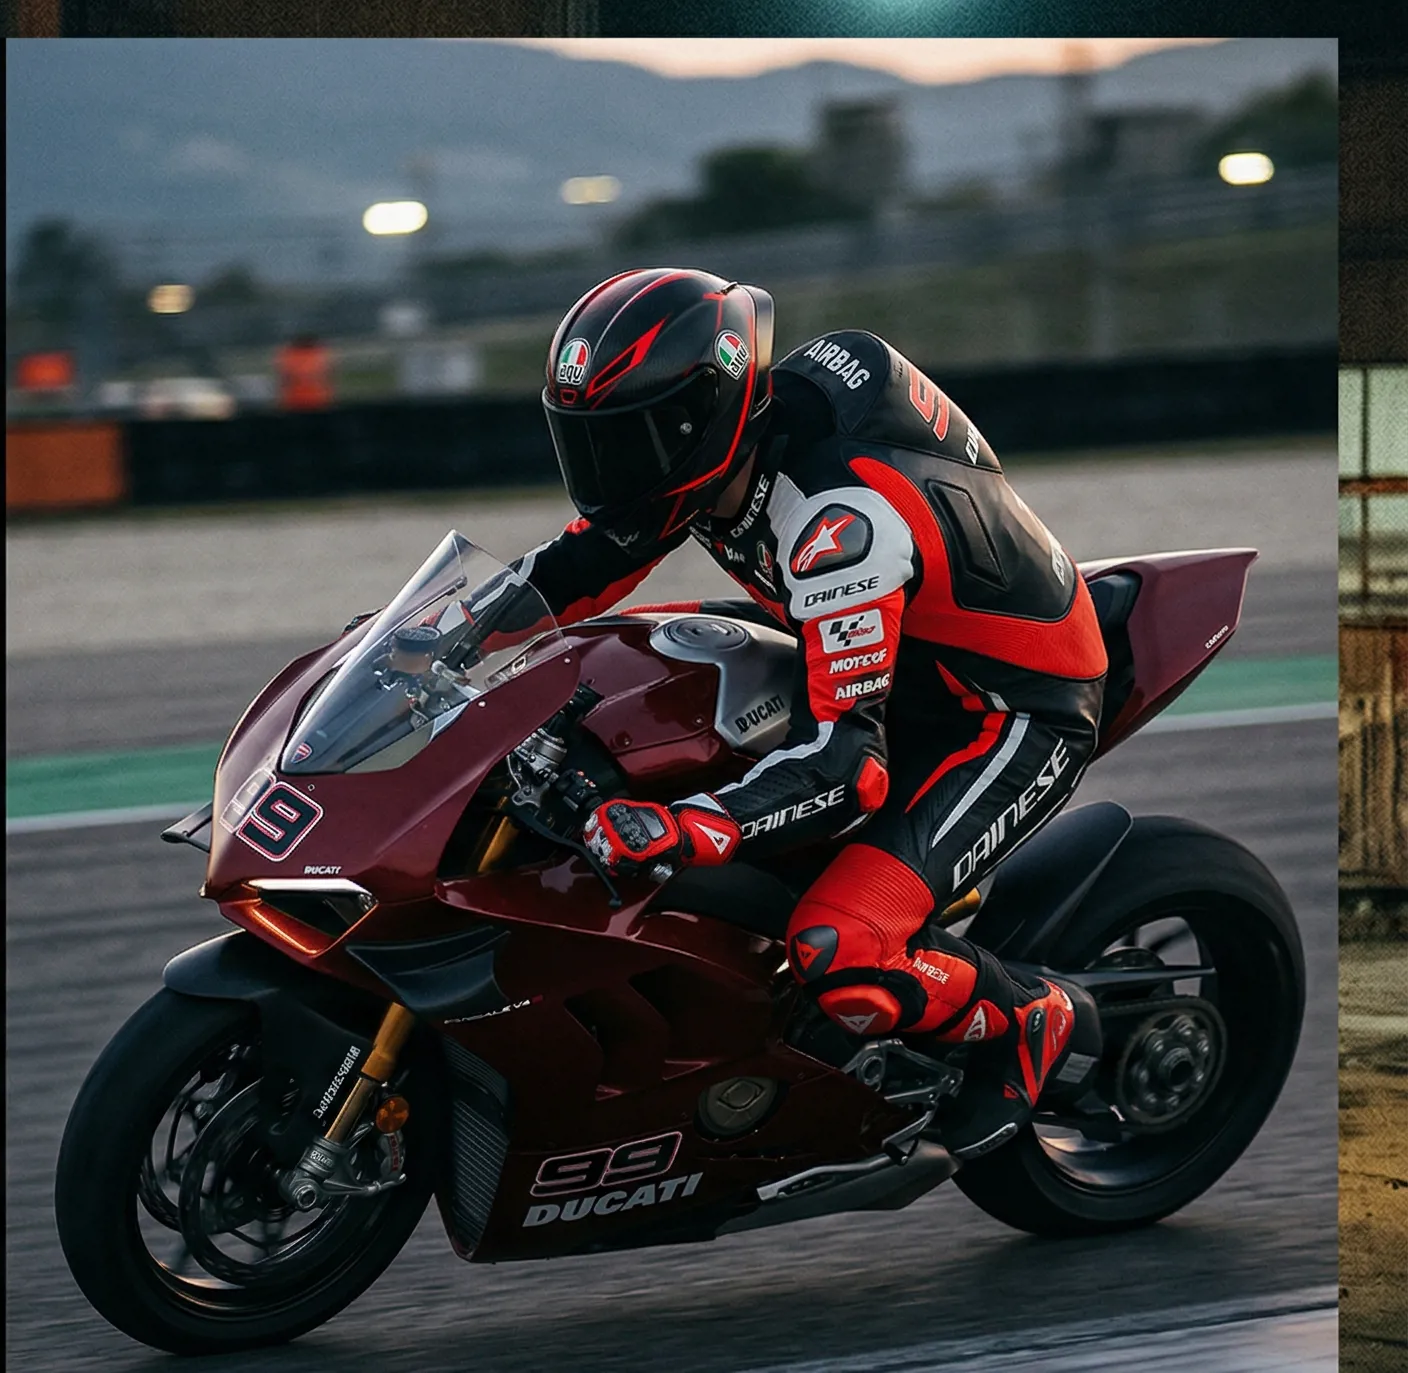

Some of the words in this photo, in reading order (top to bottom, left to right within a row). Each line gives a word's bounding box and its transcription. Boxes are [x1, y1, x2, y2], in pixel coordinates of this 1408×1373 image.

[803, 339, 871, 390] AIRBAG
[803, 575, 880, 608] DAINESE
[734, 694, 785, 734] DUCATI
[741, 783, 846, 840] DAINESE
[951, 737, 1070, 893] DAINESE
[529, 1130, 683, 1197] 99
[521, 1171, 705, 1228] DUCATI
